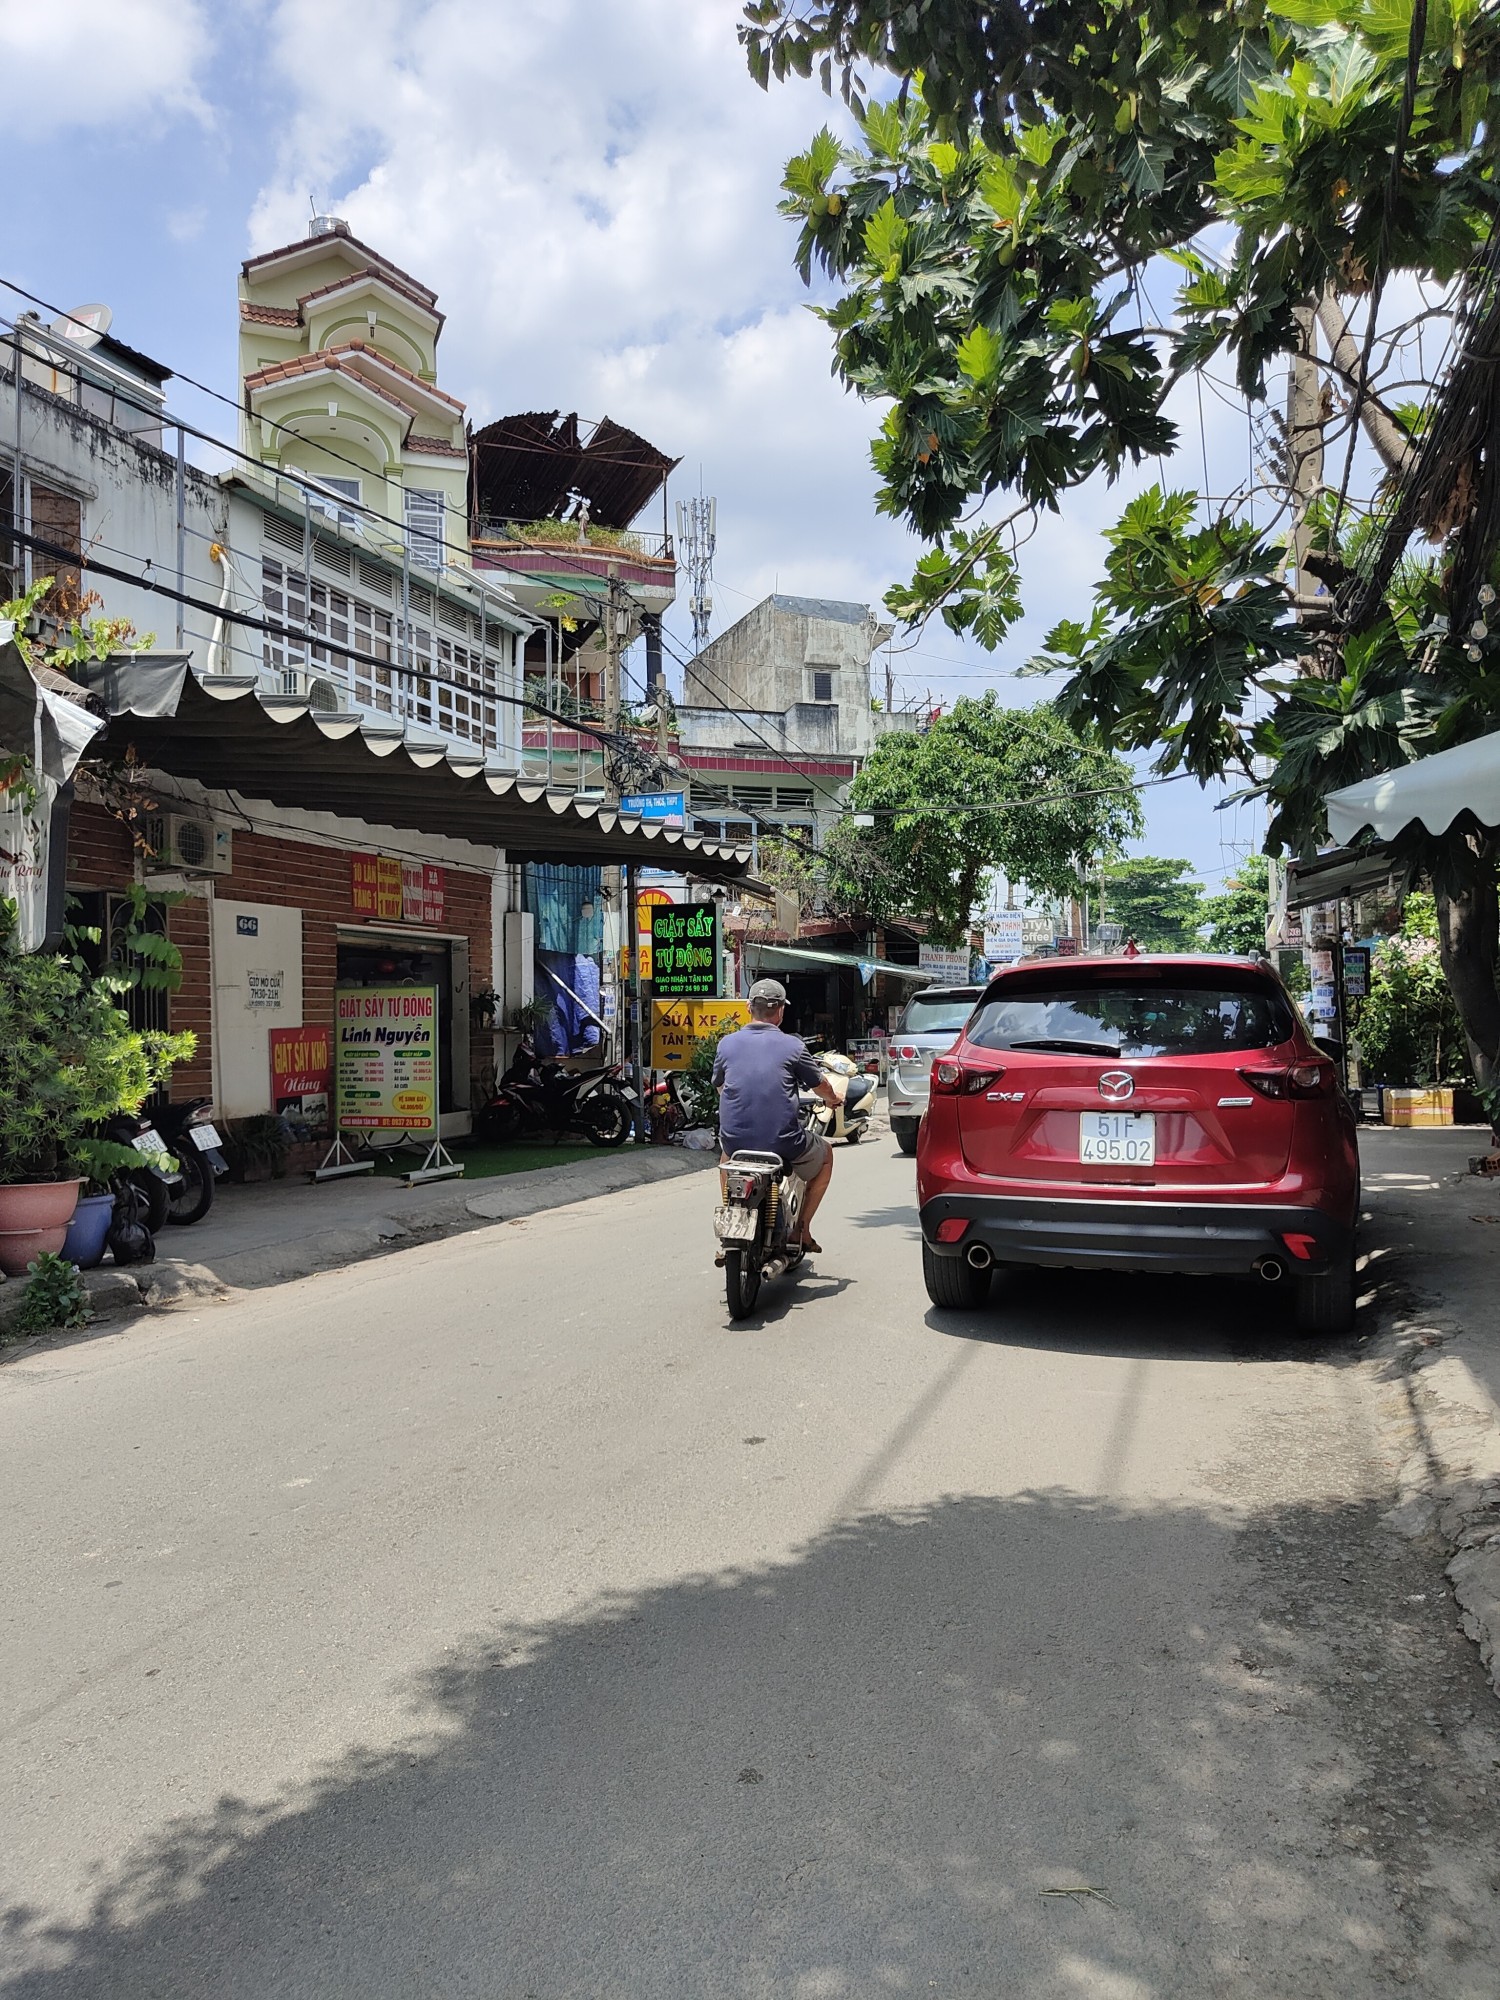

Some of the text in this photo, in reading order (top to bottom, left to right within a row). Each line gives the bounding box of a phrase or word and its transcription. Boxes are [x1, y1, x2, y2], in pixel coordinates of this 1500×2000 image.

[628, 796, 644, 808] TRƯỜNG
[353, 862, 362, 882] 10
[373, 890, 377, 910] 1
[240, 918, 256, 930] 66
[654, 908, 714, 942] GIẶT SẤY
[1022, 932, 1050, 943] offee
[656, 942, 712, 972] TỰ ĐỘNG
[921, 953, 968, 964] THANH PHONG
[671, 975, 688, 984] NHẬN
[689, 975, 701, 984] TẬN
[251, 988, 278, 1000] 7H30-21H
[340, 991, 432, 1022] GIẶT SẤY TỰ ĐỘNG
[662, 1010, 717, 1026] SỬA XE
[342, 1024, 430, 1046] Linh Nguyễn
[662, 1032, 683, 1046] TÂN
[275, 1030, 328, 1078] GIẶT SẤY KHÔ
[986, 1092, 1025, 1102] CX-5
[1098, 1117, 1134, 1138] 51F
[1083, 1140, 1151, 1161] 495.02
